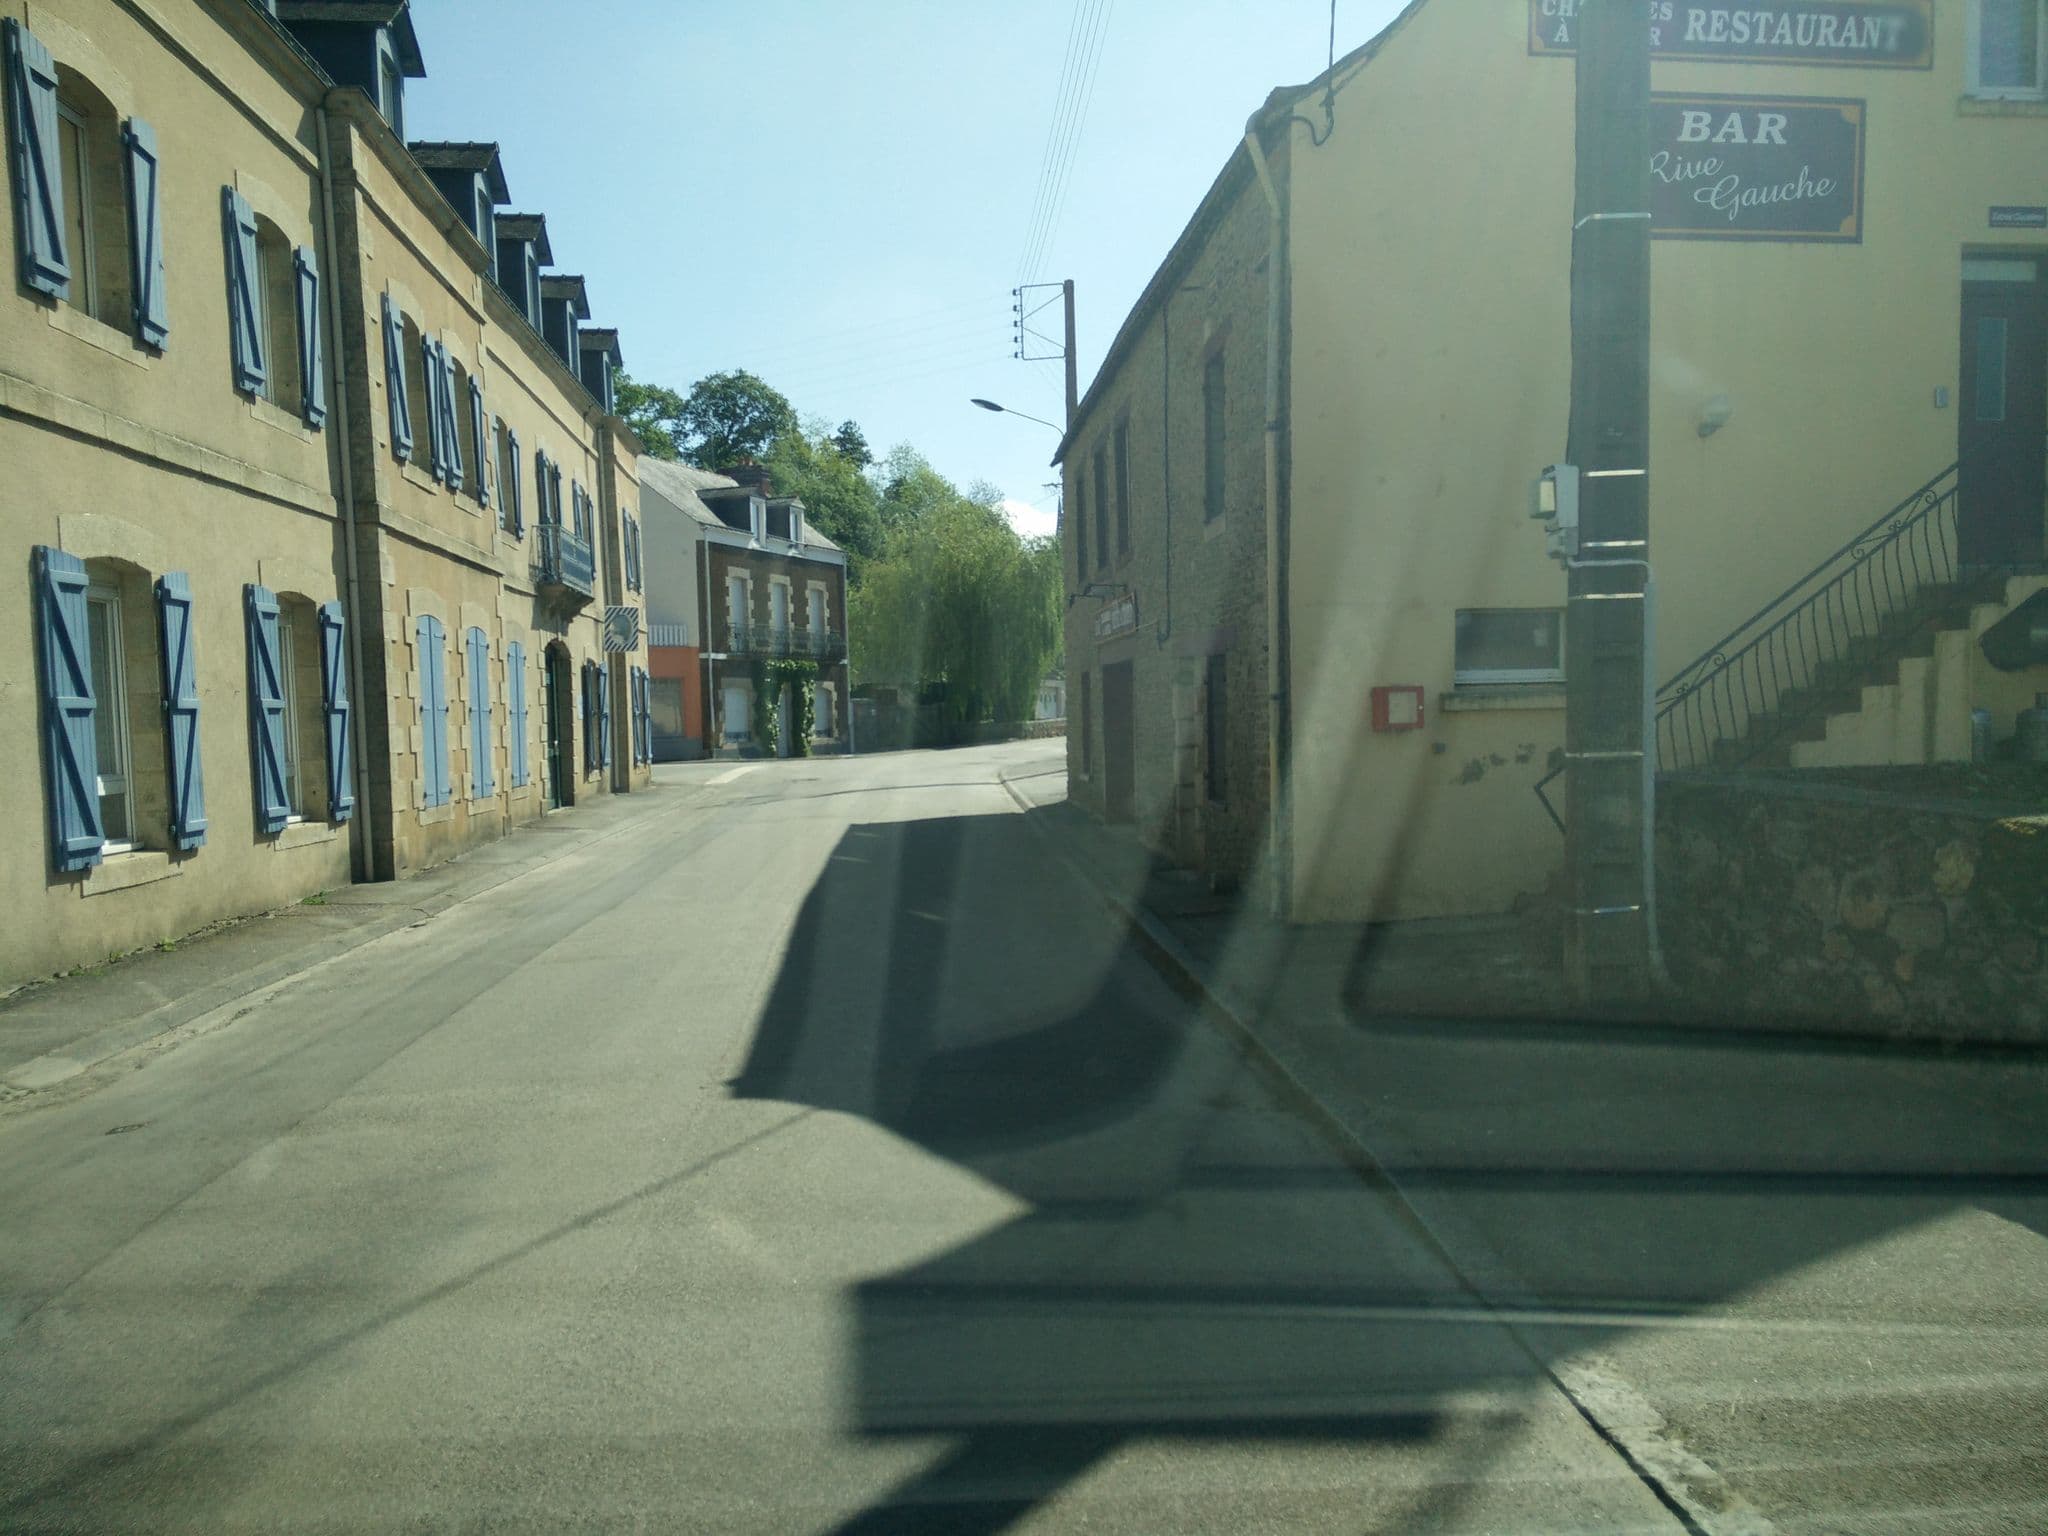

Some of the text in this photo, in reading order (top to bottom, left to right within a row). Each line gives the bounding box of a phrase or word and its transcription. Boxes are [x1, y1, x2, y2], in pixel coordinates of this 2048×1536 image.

[1684, 8, 1906, 50] RESTAURANT
[1677, 110, 1788, 144] BAR
[1650, 151, 1724, 184] Rive
[1694, 165, 1838, 221] Gauche
